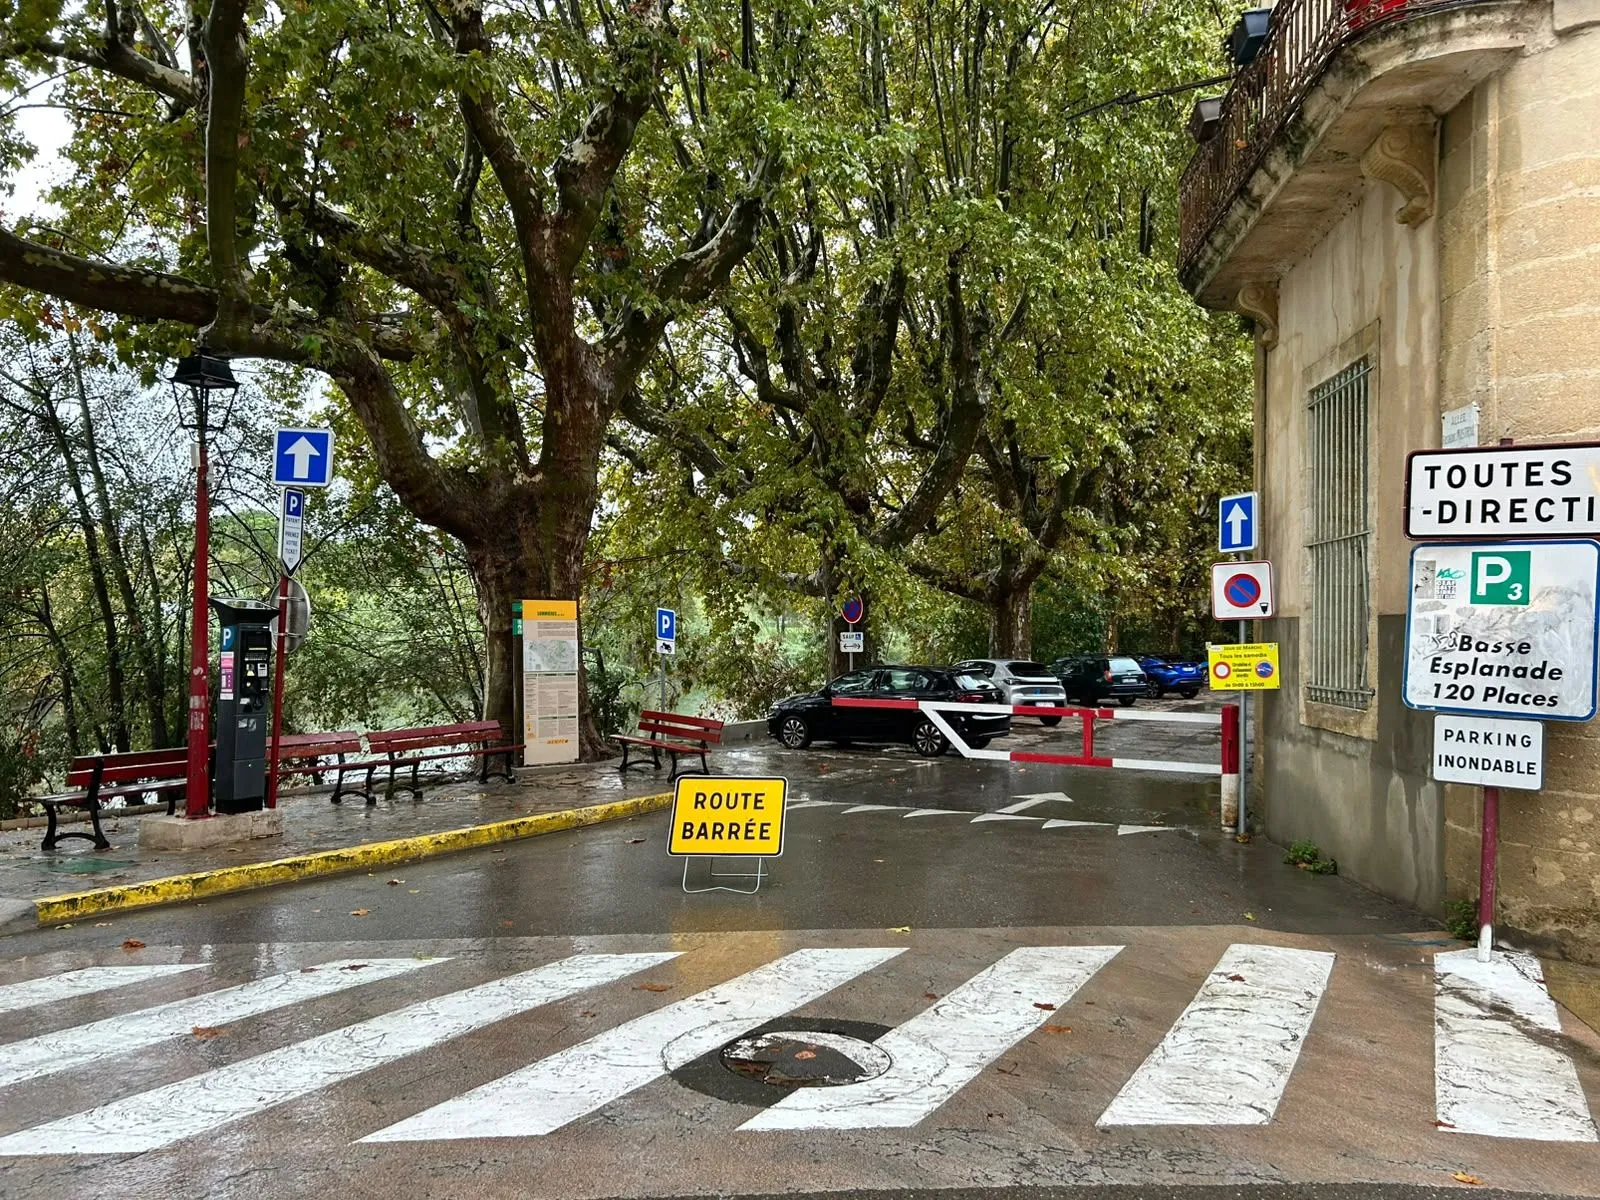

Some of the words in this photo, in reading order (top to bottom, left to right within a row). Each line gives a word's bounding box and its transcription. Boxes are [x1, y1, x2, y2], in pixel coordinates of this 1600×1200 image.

[1424, 460, 1572, 489] TOUTES
[289, 495, 298, 512] P
[661, 615, 671, 633] P
[223, 628, 232, 646] P
[1458, 634, 1531, 656] Basse
[1430, 656, 1563, 680] Esplanade
[1433, 683, 1475, 701] 120
[1482, 686, 1559, 707] Places
[1444, 729, 1532, 748] PARKING
[1438, 754, 1537, 775] INONDABLE
[694, 792, 766, 810] ROUTE
[681, 818, 771, 840] BARRÉE
